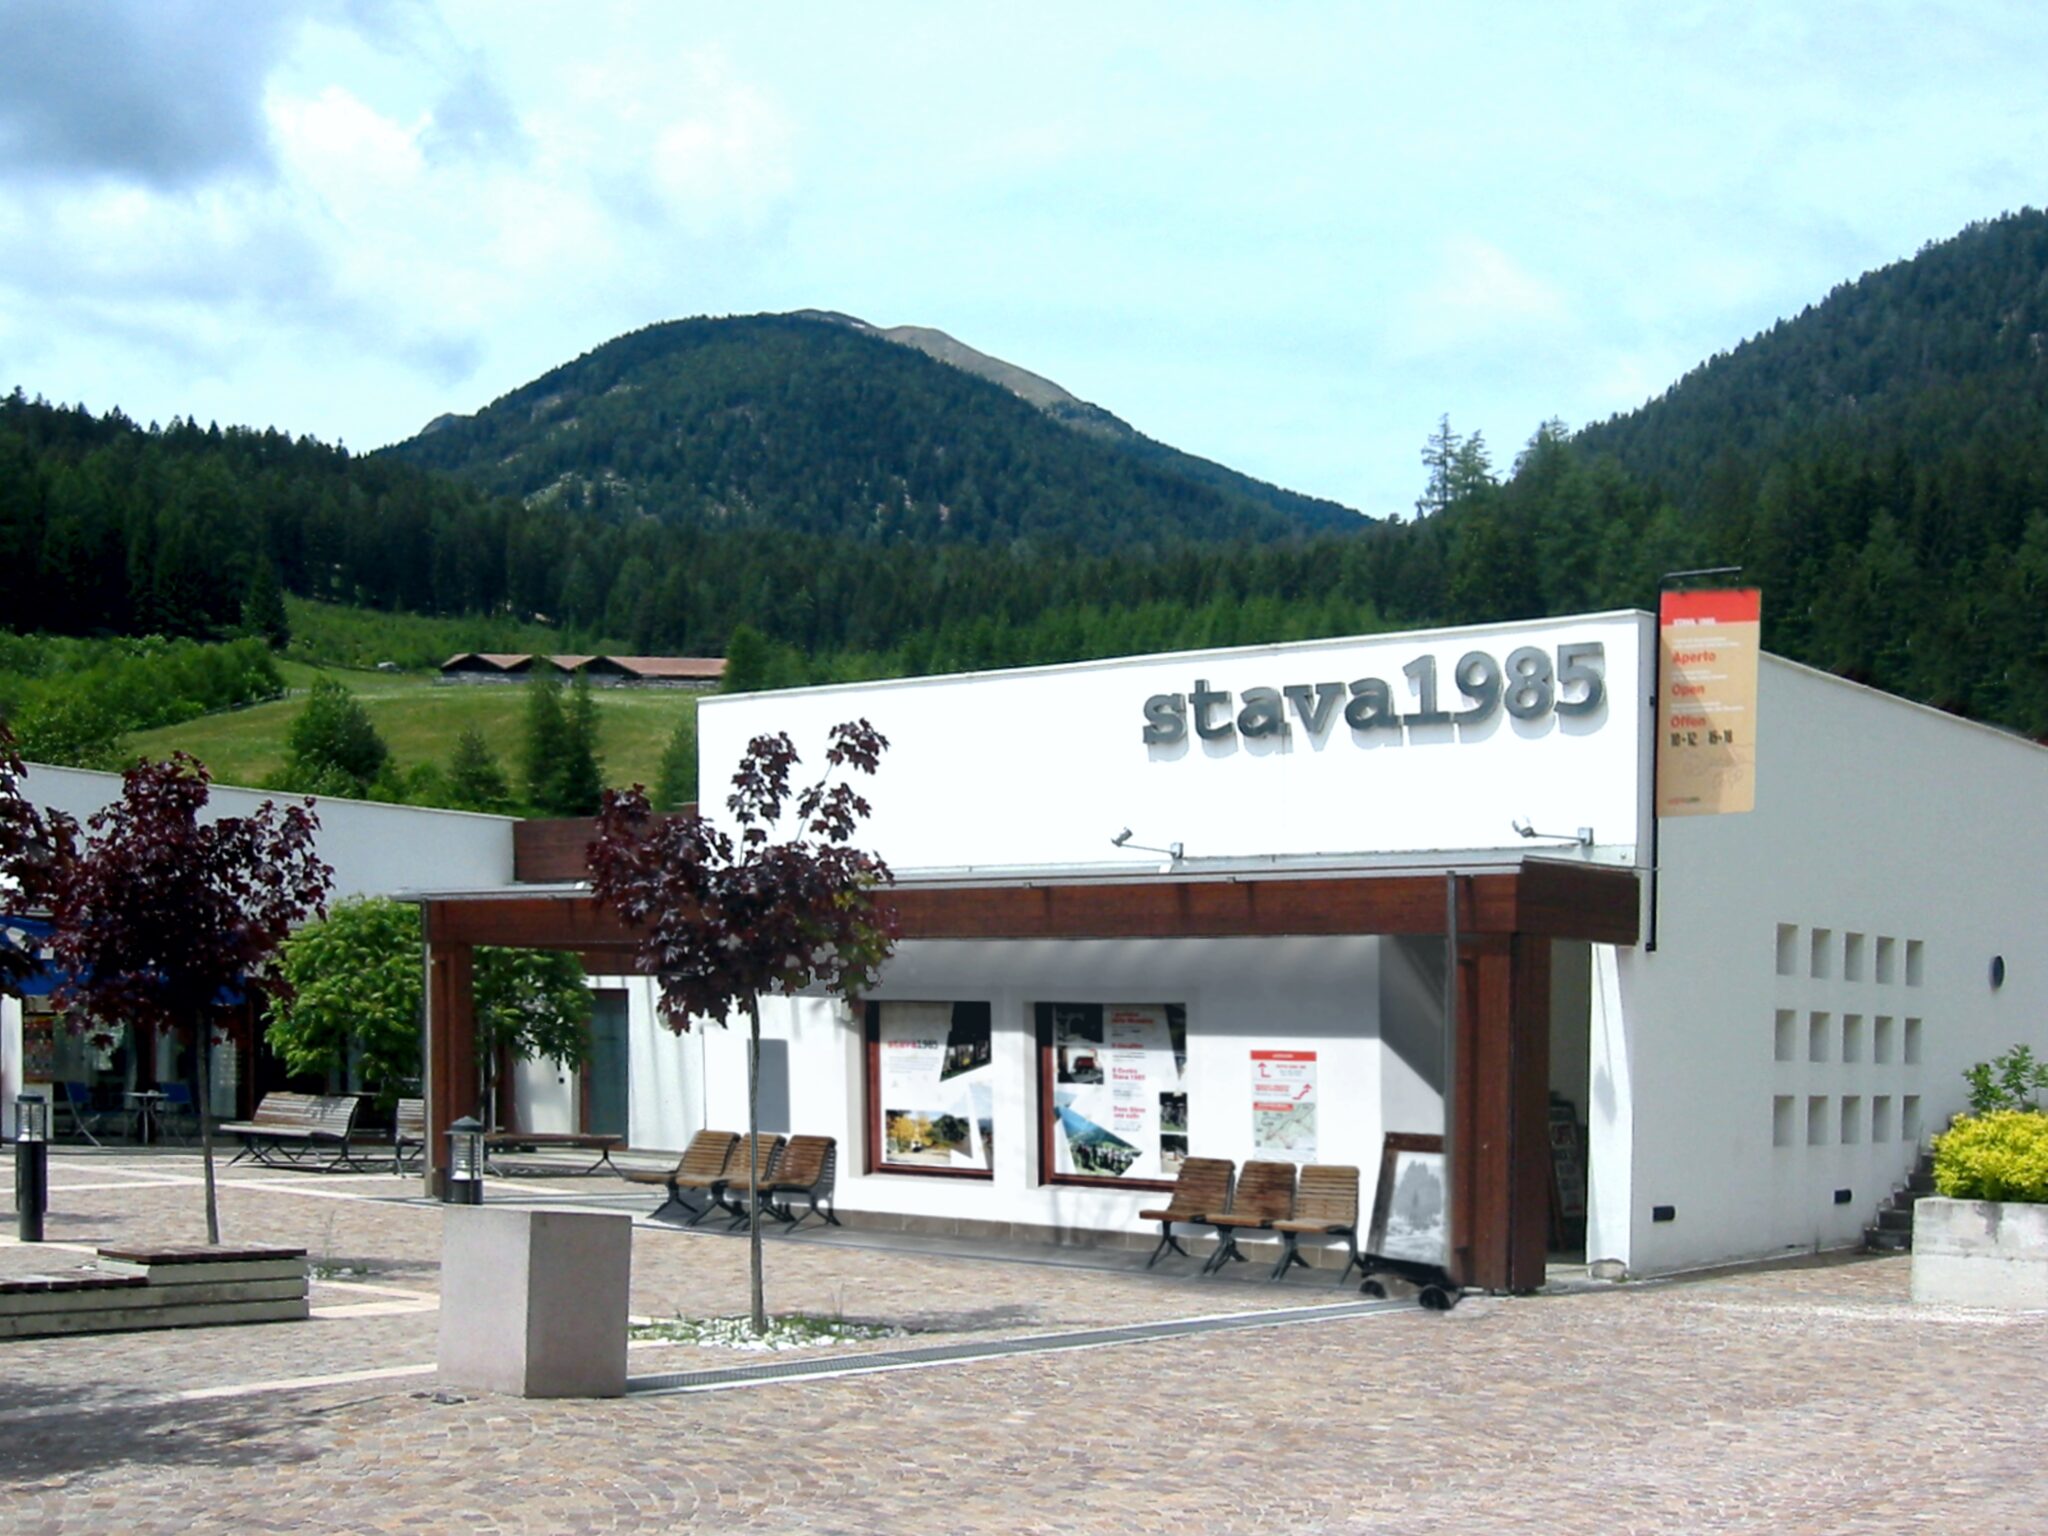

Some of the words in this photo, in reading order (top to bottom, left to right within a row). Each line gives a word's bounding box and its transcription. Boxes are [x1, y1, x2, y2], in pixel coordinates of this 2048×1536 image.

[1673, 651, 1716, 665] Aperto
[1143, 641, 1606, 745] stava1985
[1671, 684, 1705, 697] Open
